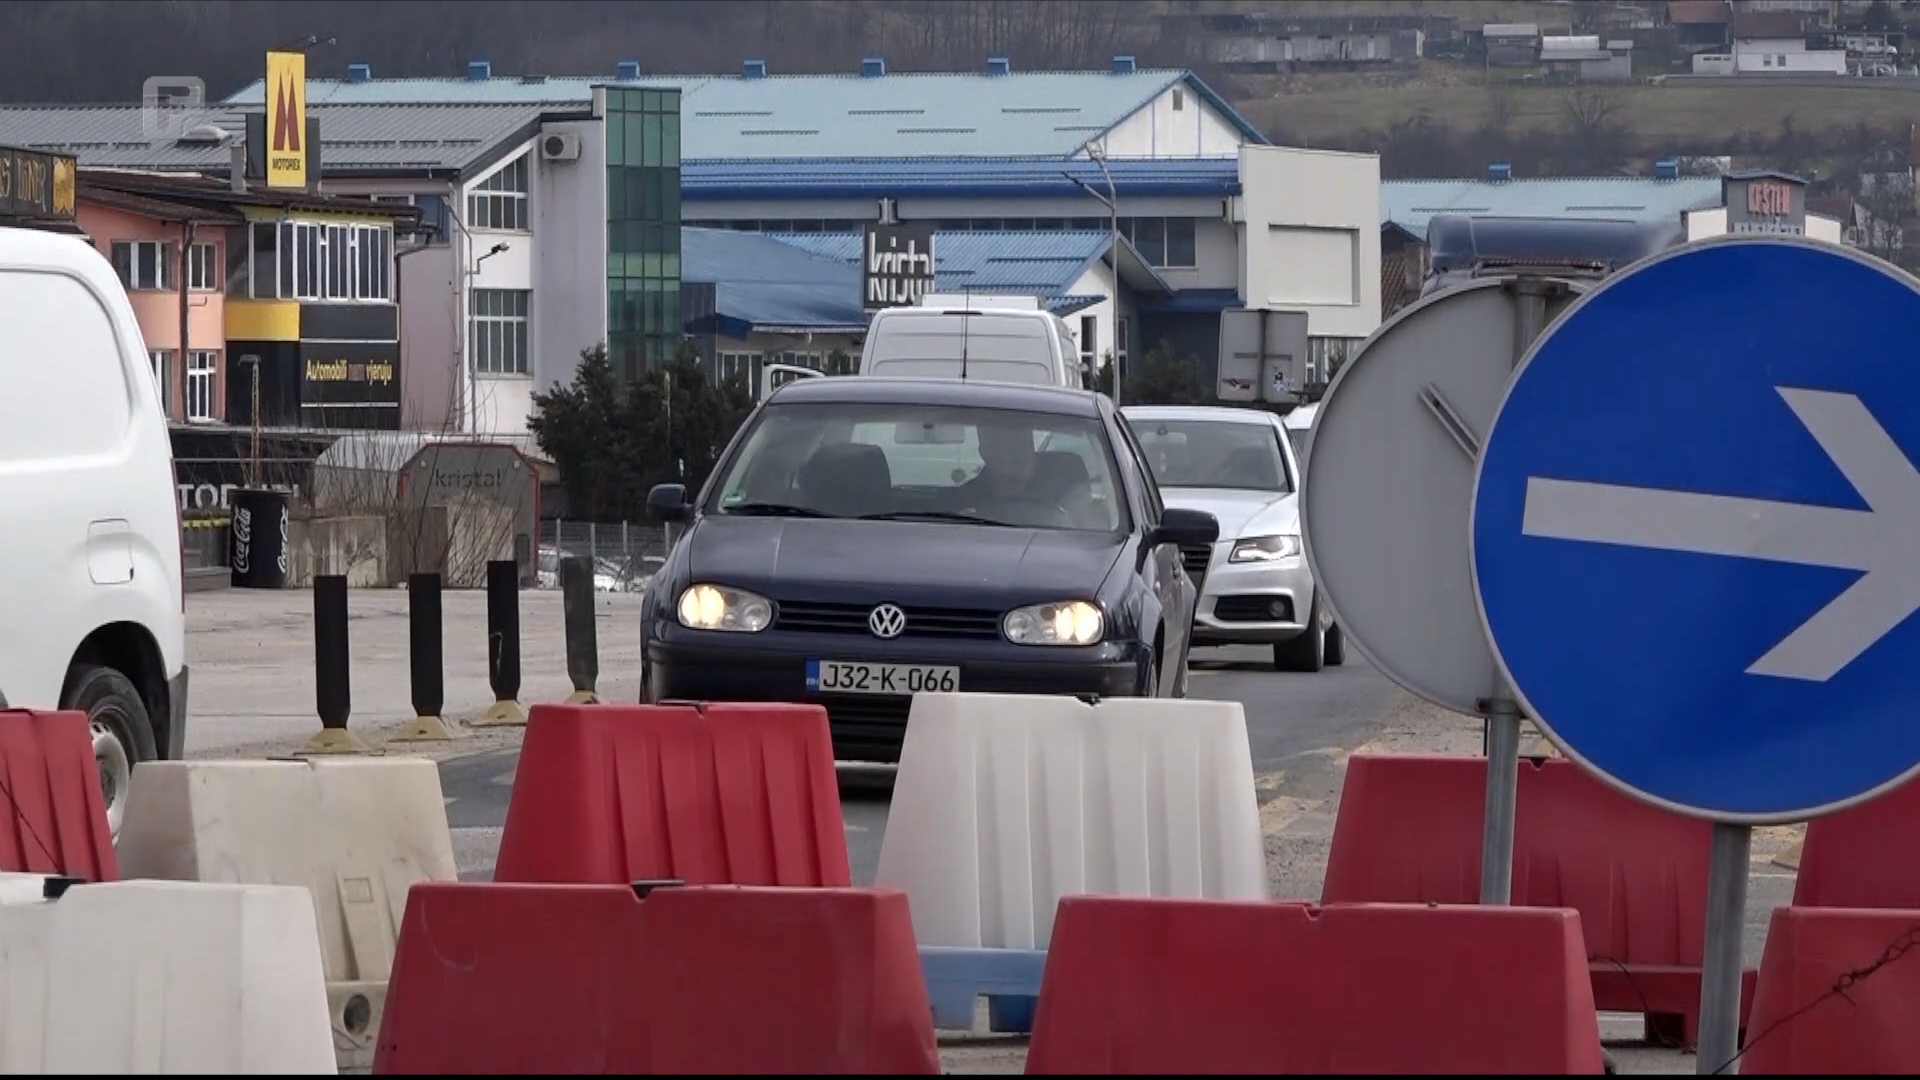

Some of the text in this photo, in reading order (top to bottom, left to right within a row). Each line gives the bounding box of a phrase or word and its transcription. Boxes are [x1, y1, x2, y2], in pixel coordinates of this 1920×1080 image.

[272, 158, 301, 171] MOTOREX
[306, 359, 347, 381] Automobili
[366, 359, 392, 387] vjeruju
[435, 468, 501, 488] kristal
[823, 663, 955, 692] J32-K-066
